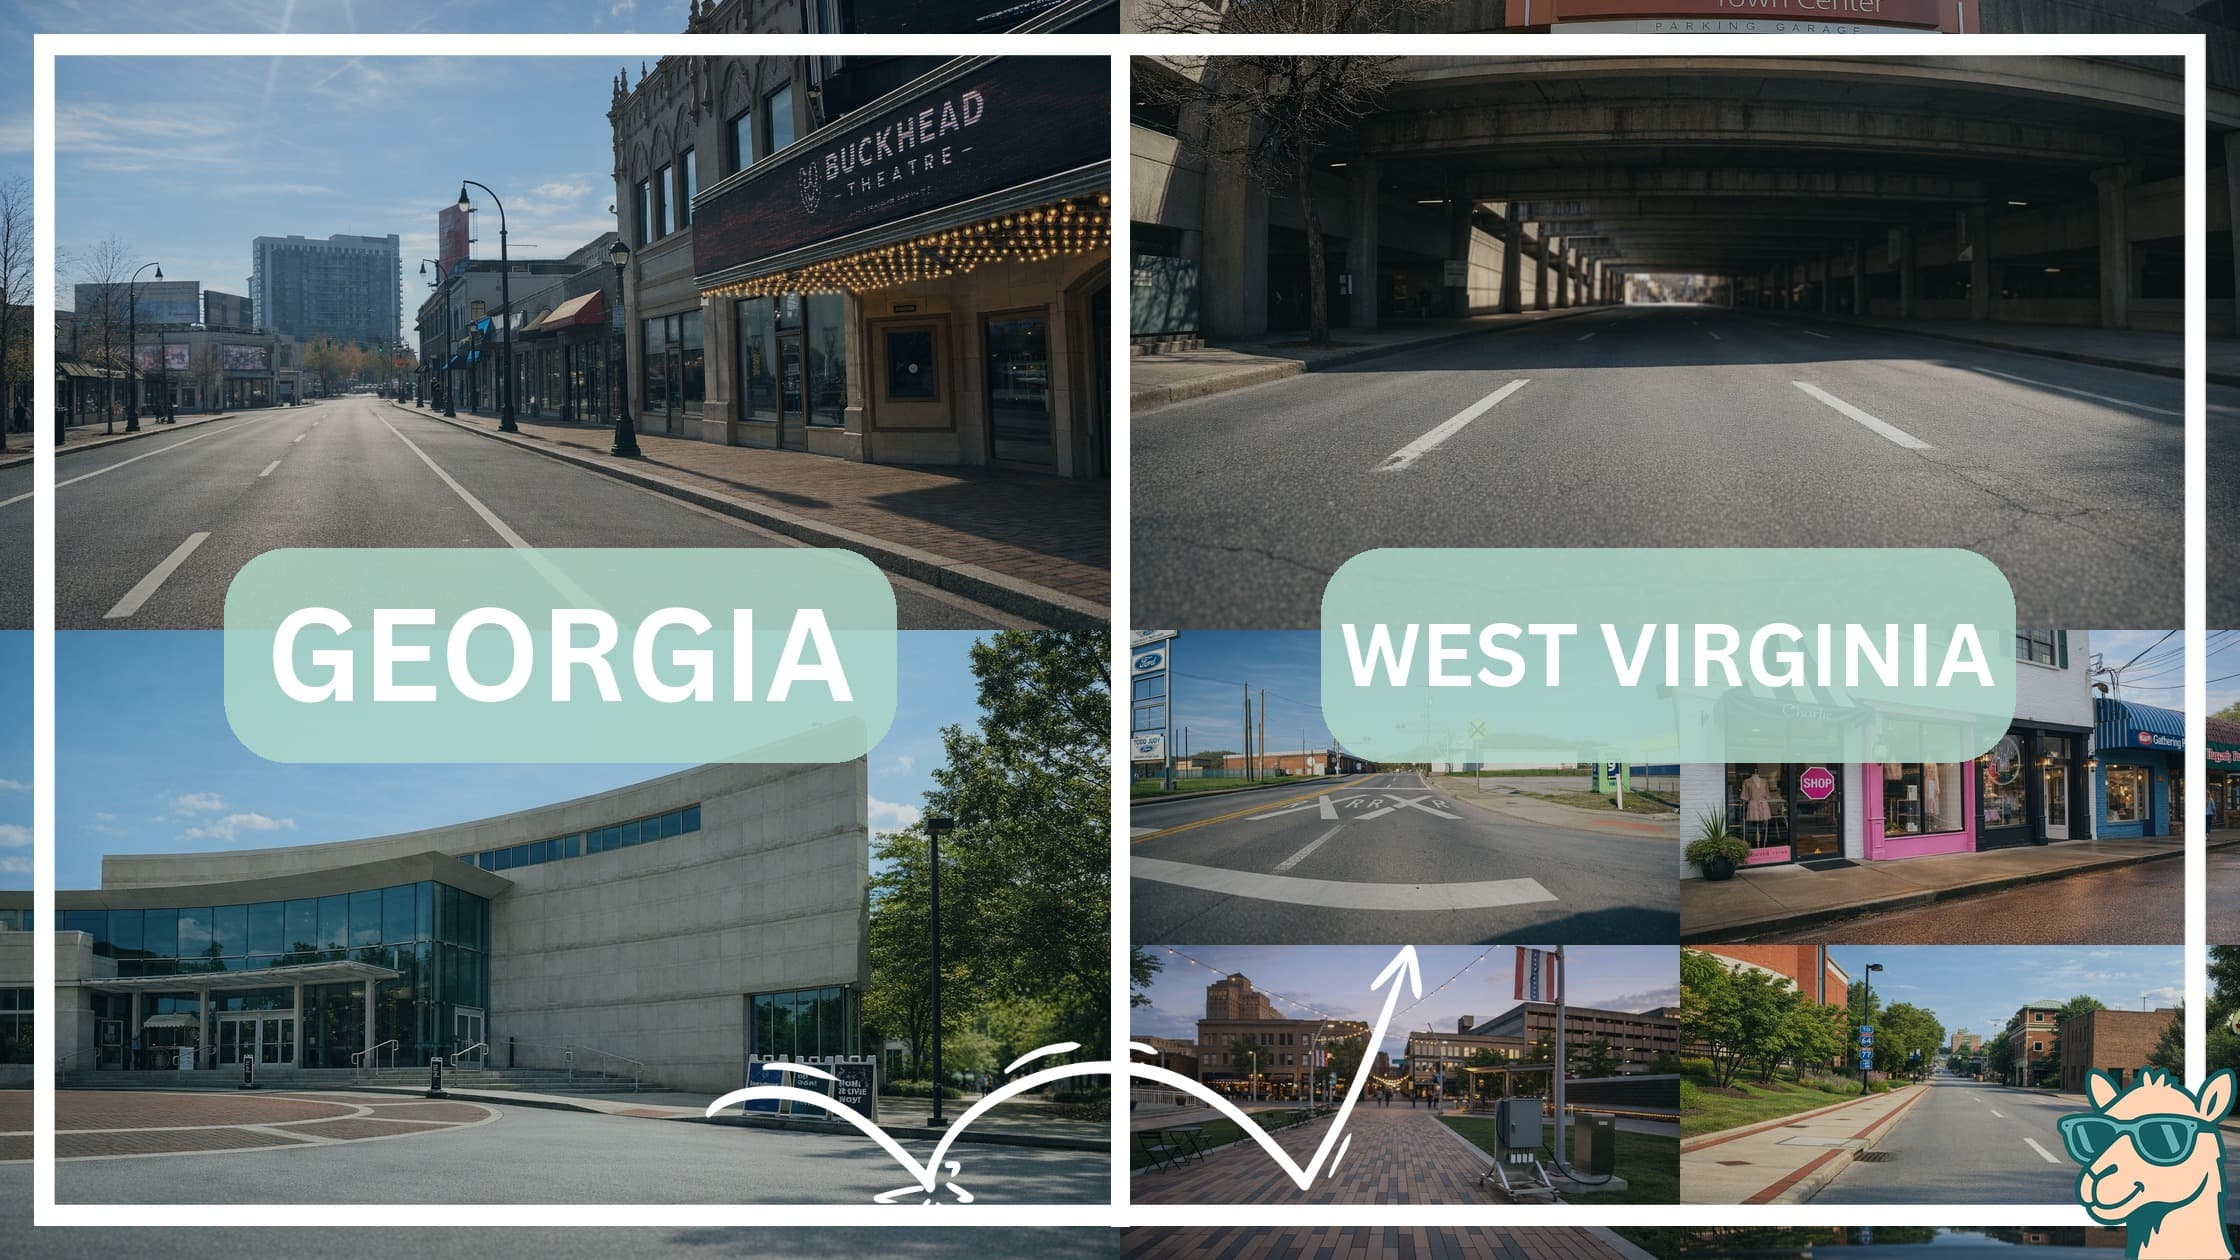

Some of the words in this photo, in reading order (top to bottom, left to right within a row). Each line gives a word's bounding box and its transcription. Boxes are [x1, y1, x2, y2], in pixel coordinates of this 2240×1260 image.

[1655, 22, 1756, 31] PARKING
[1776, 22, 1861, 34] GARAGE
[825, 89, 984, 182] BUCKHEAD
[847, 146, 952, 196] THEATRE
[2152, 734, 2181, 749] Gathering
[1803, 778, 1832, 789] SHOP
